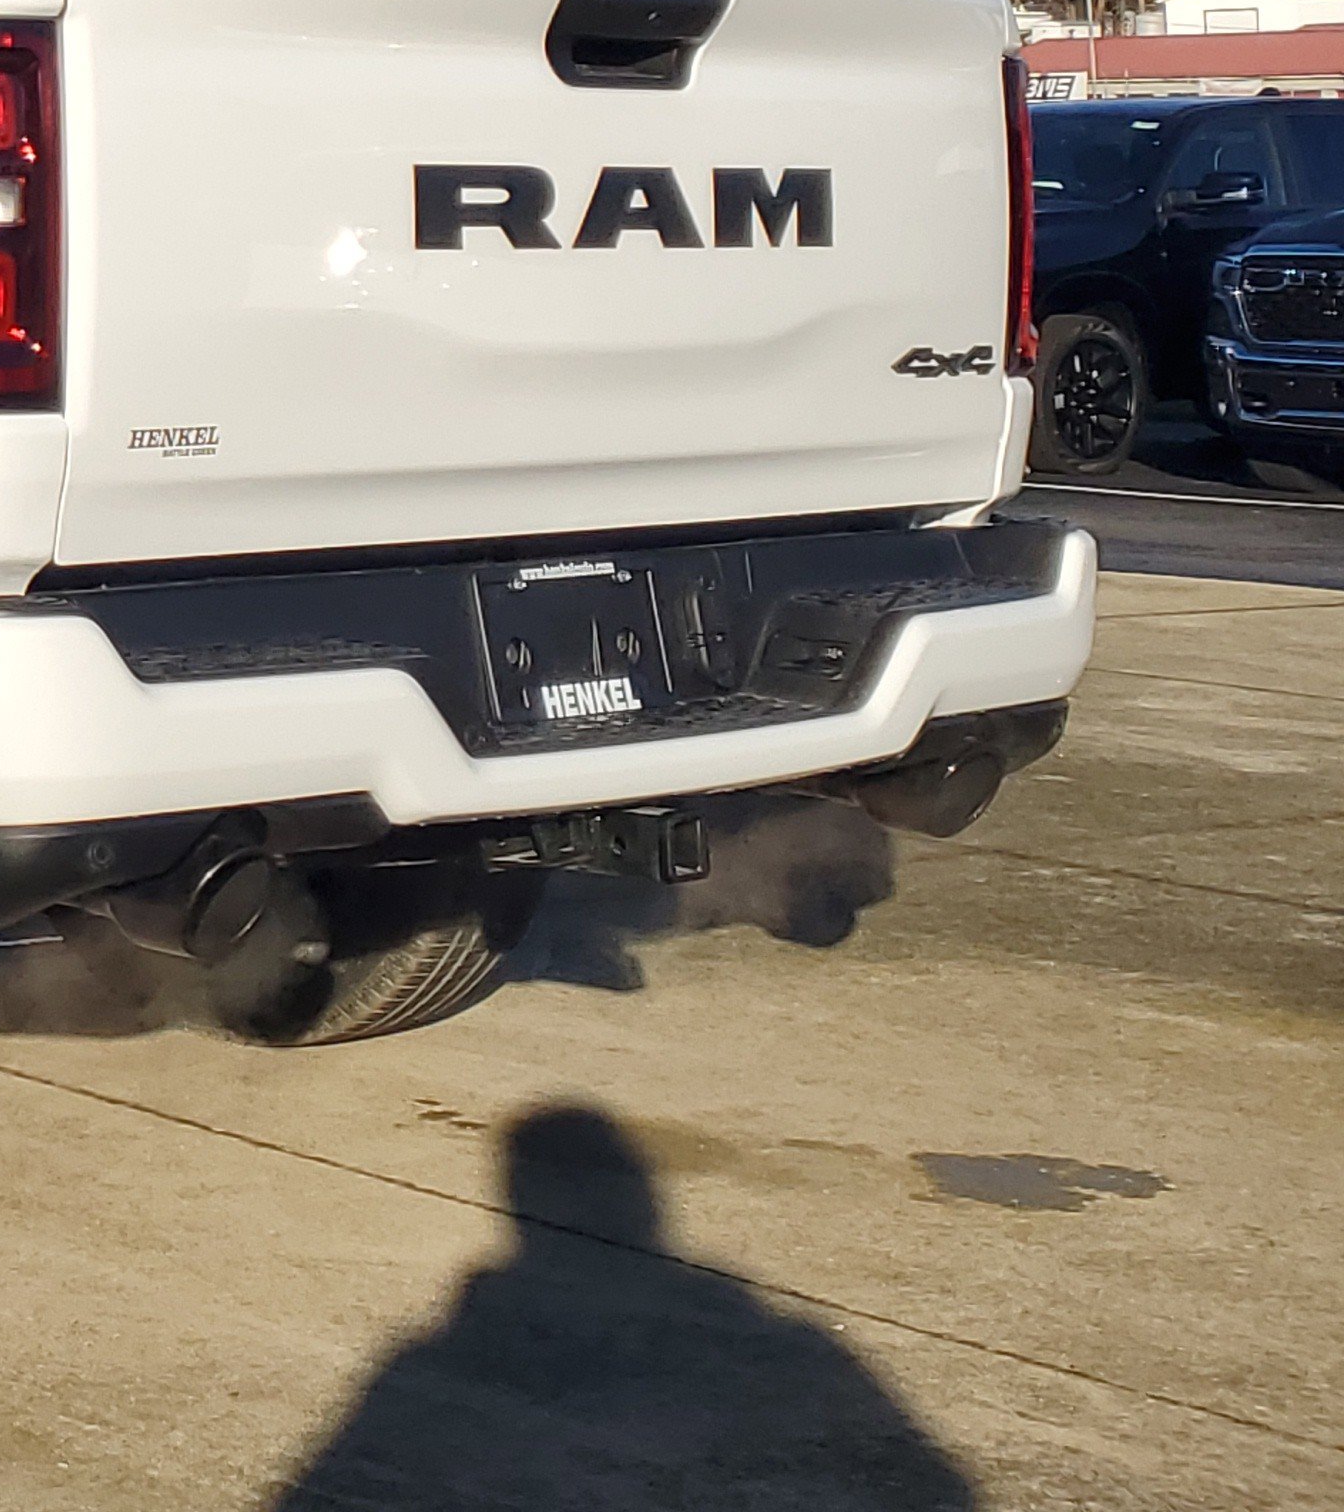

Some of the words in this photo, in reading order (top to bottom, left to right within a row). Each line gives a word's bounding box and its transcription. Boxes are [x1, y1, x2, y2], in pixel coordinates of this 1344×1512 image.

[413, 163, 834, 250] RAM
[127, 426, 220, 449] HENKEL
[541, 677, 642, 719] HENKEL
